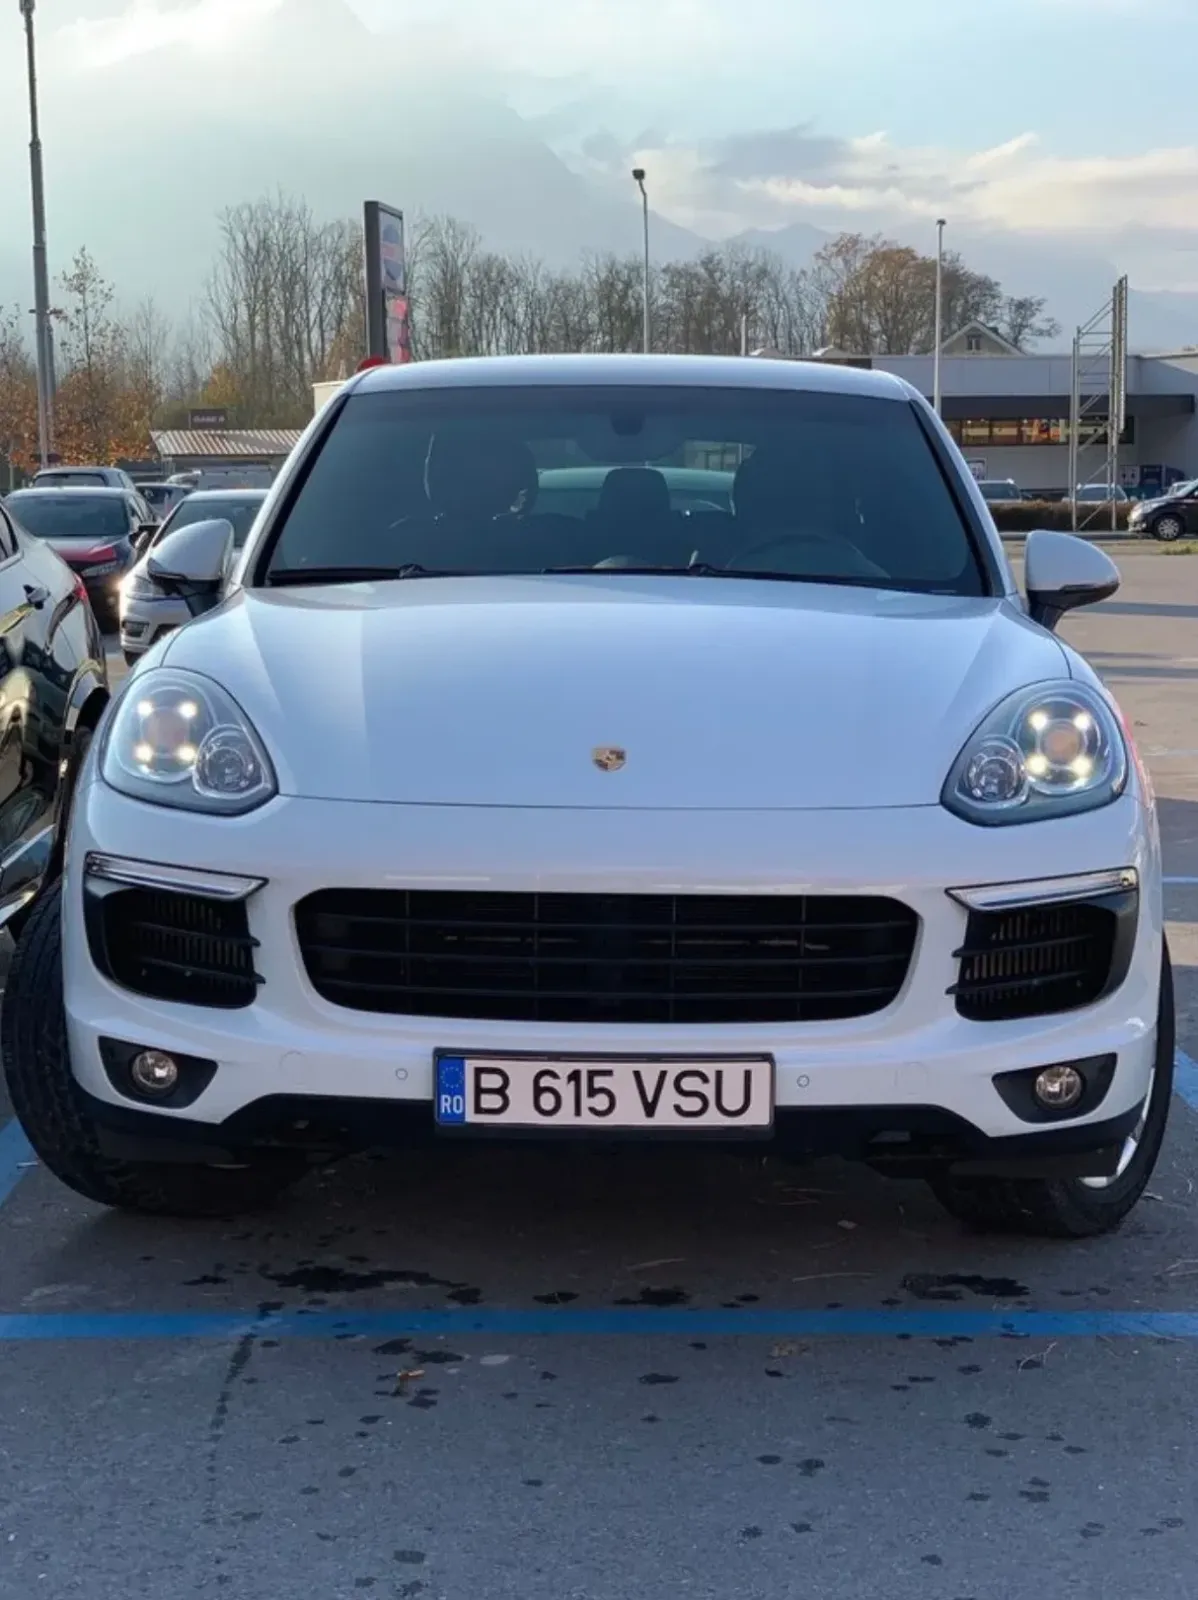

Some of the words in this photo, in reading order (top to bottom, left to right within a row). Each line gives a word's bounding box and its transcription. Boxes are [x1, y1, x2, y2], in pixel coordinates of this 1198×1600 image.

[440, 1095, 463, 1114] RO
[473, 1066, 511, 1115] B
[532, 1068, 617, 1117] 615
[632, 1069, 752, 1118] VSU
